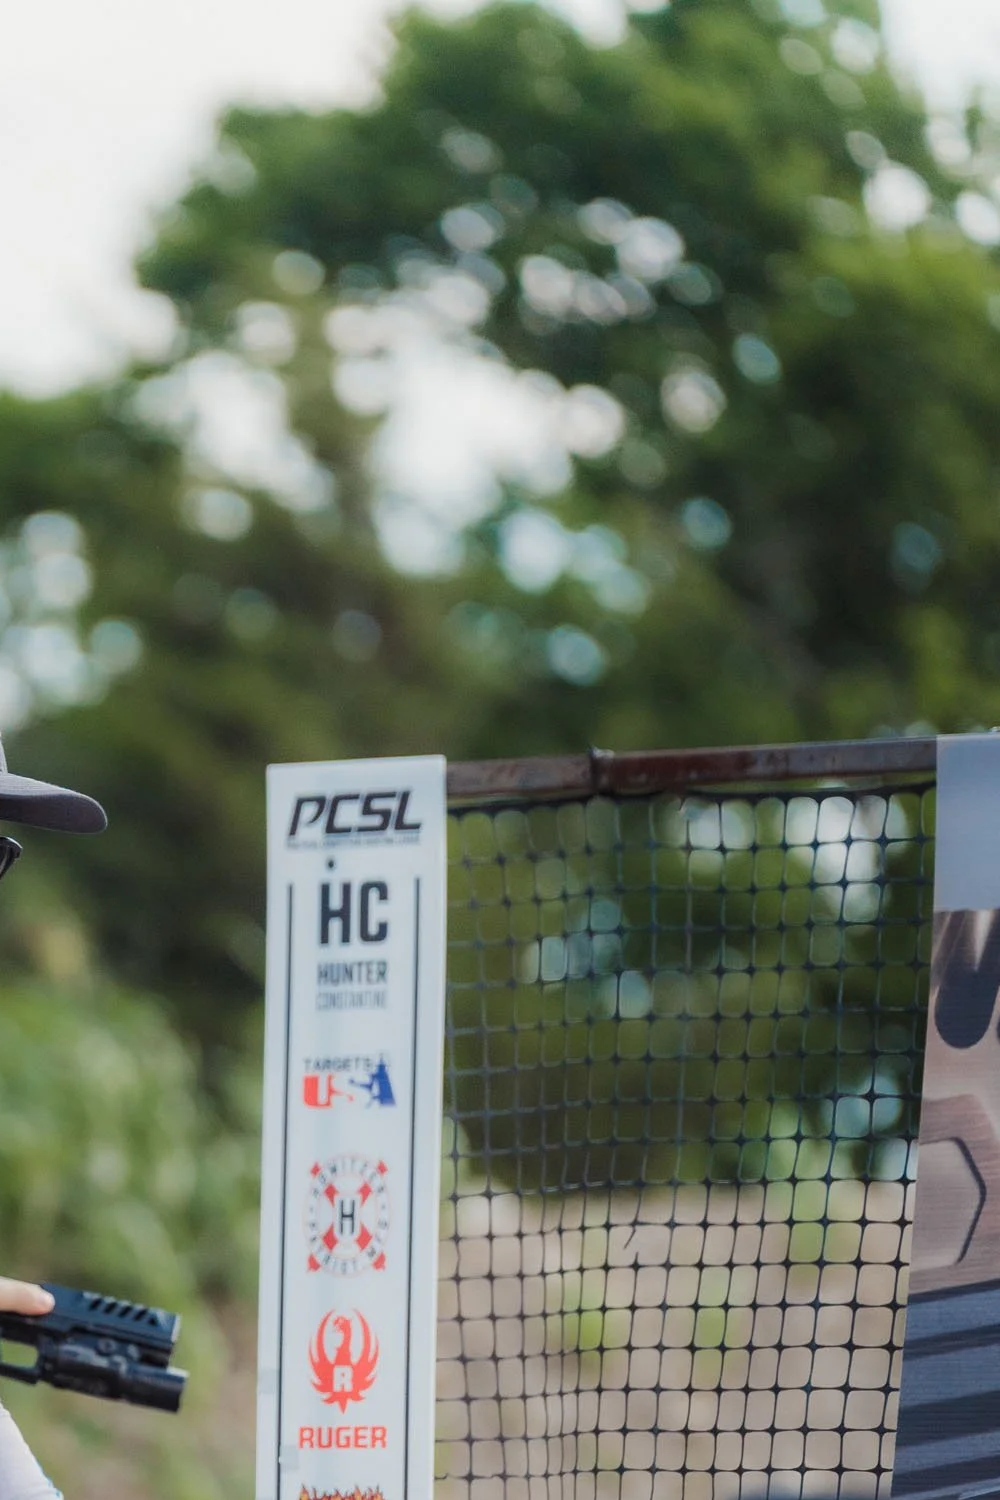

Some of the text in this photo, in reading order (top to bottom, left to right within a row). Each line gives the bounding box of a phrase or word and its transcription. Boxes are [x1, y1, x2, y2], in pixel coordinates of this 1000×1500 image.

[289, 790, 422, 836] PCSL
[320, 881, 389, 944] HC
[317, 960, 387, 985] HUNTER
[303, 1056, 373, 1072] TARGETS
[340, 1199, 355, 1235] H
[333, 1365, 353, 1391] R
[299, 1426, 387, 1449] RUGER
